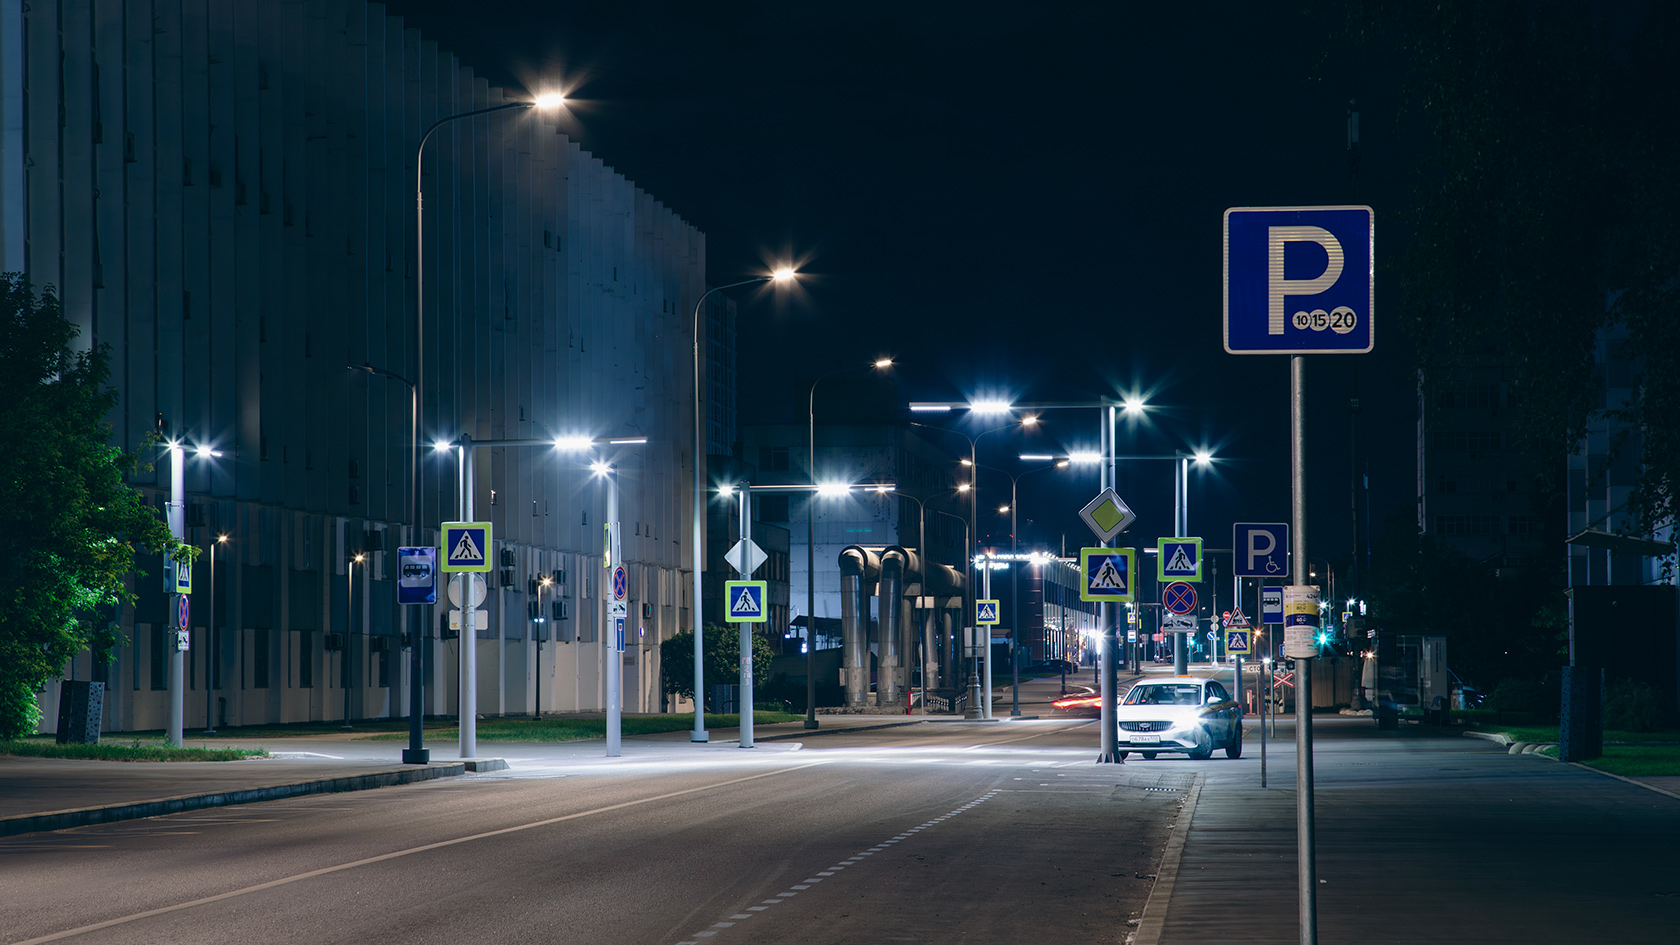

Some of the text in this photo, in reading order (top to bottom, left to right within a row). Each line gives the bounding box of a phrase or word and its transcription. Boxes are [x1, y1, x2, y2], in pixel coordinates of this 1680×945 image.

[1268, 225, 1345, 335] P
[1296, 312, 1355, 328] 10 15 20
[1248, 529, 1276, 570] P
